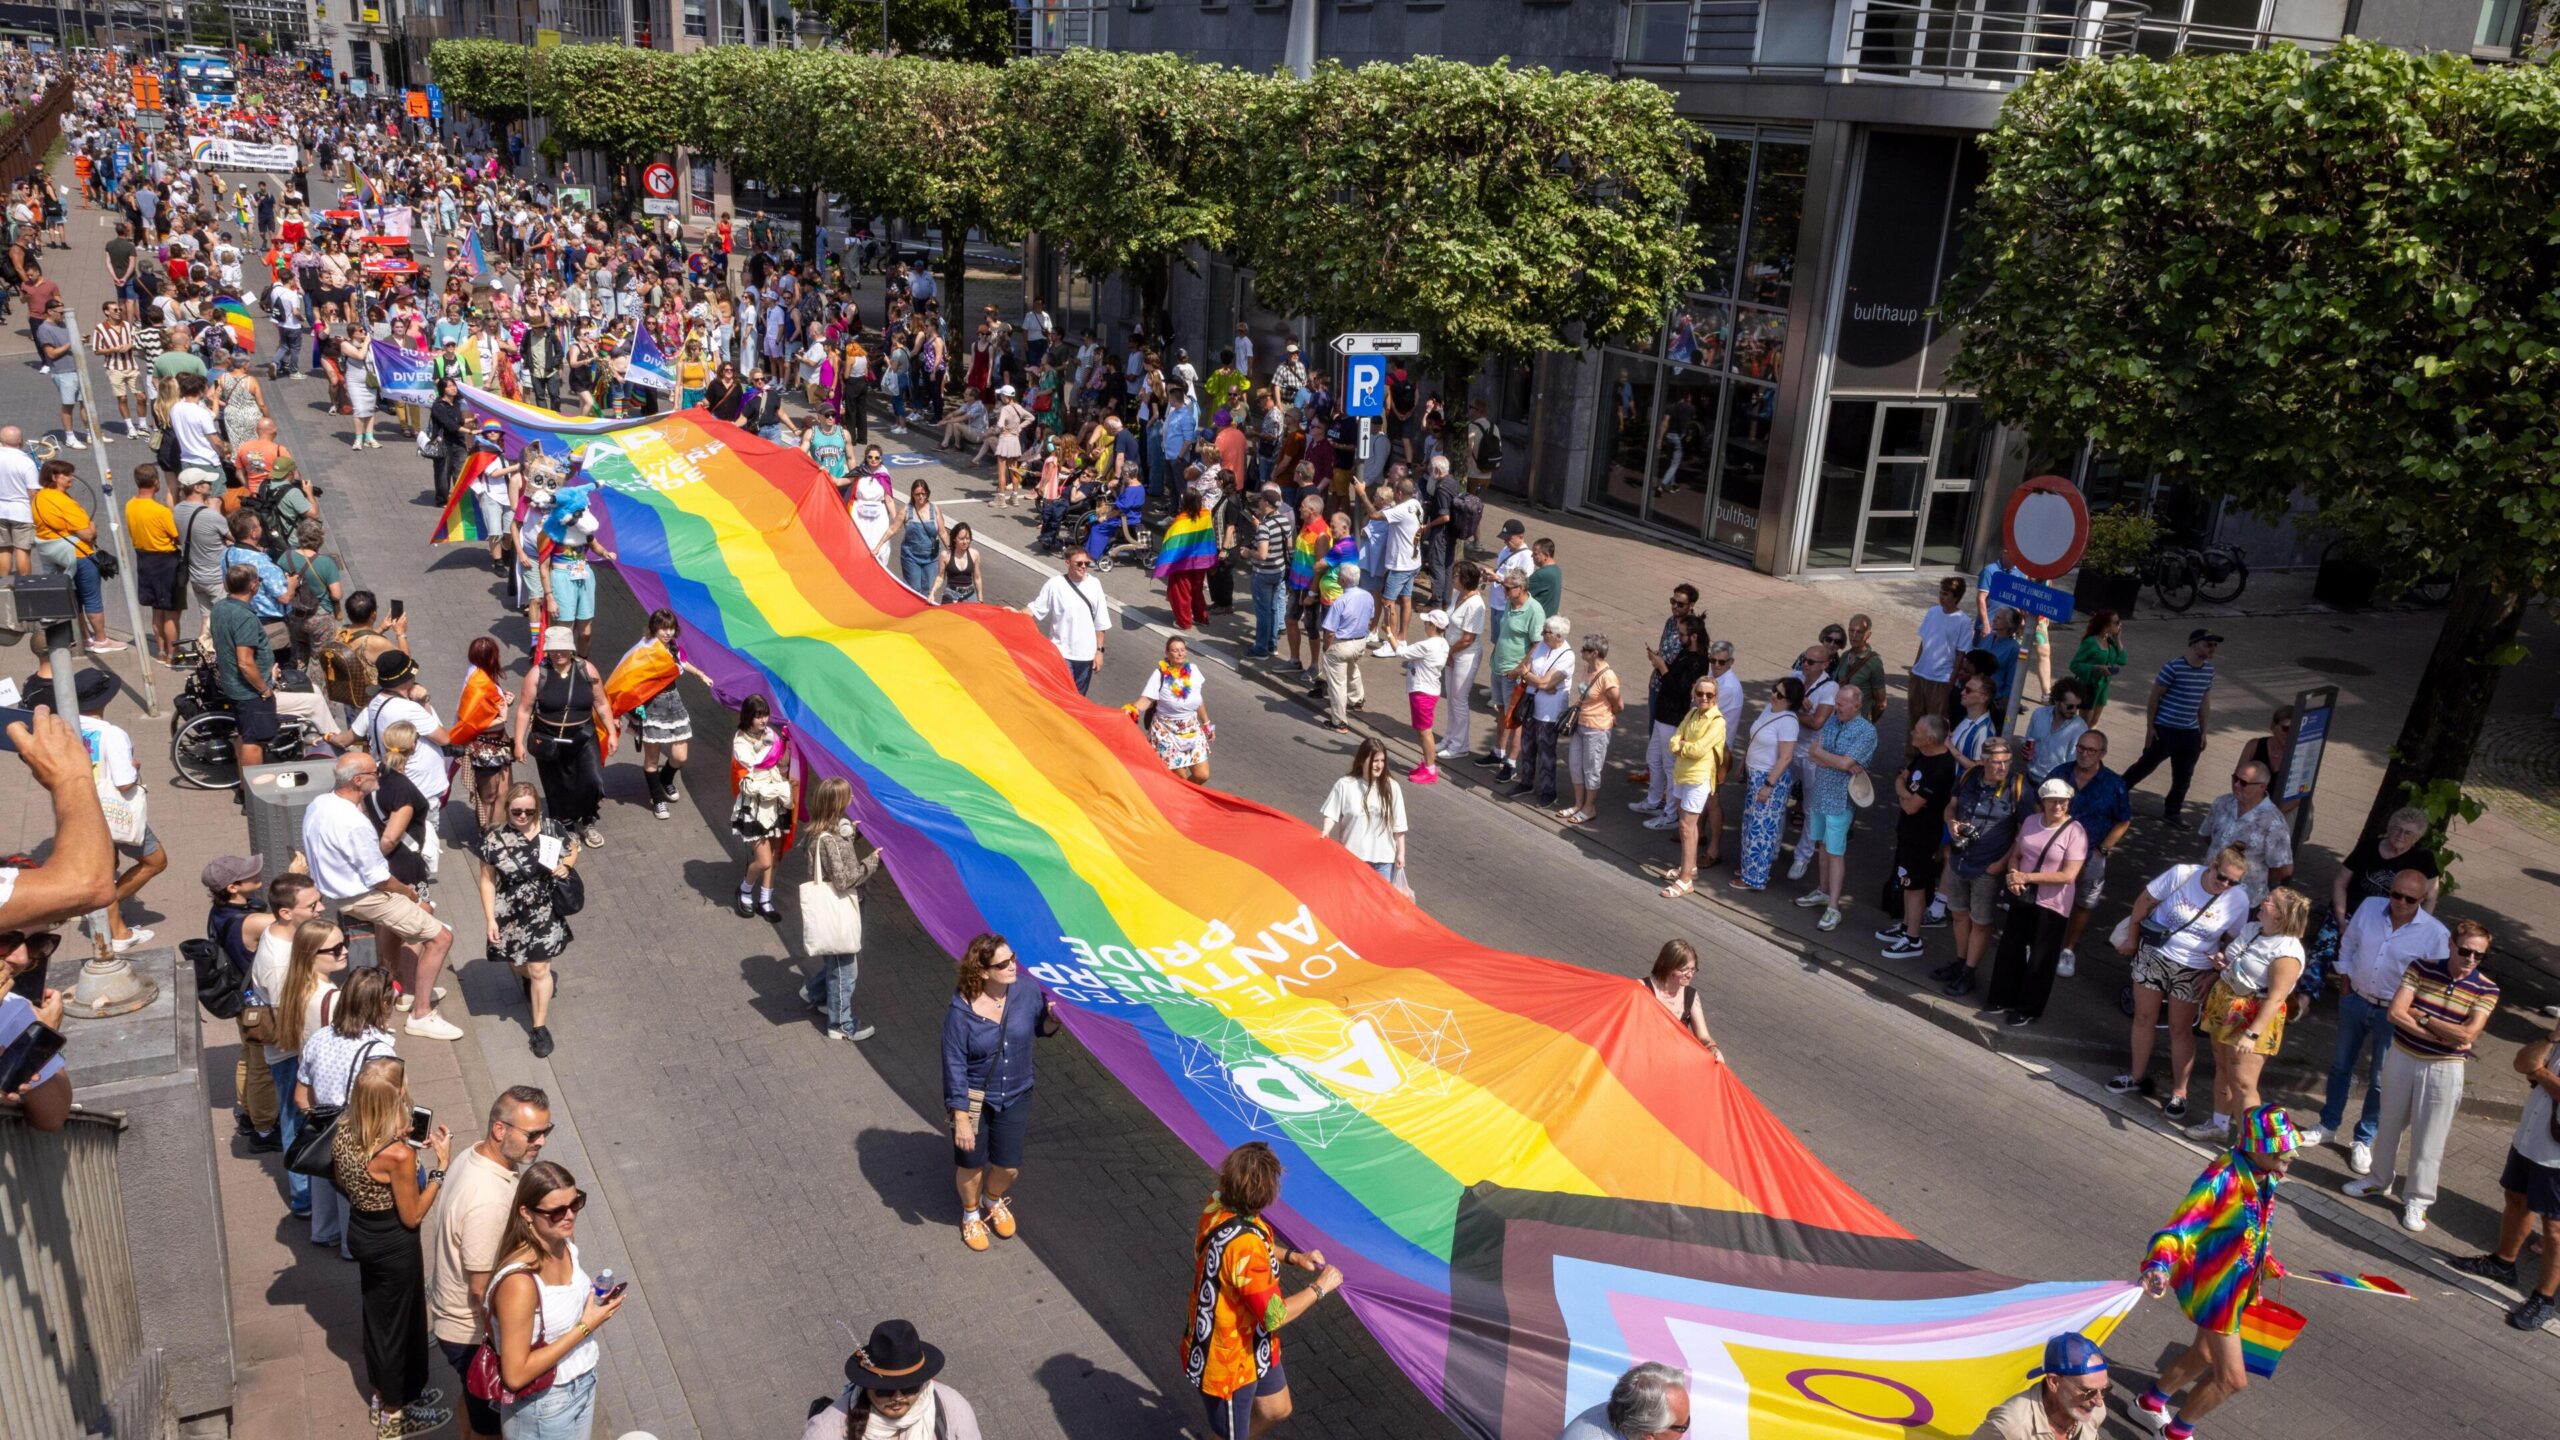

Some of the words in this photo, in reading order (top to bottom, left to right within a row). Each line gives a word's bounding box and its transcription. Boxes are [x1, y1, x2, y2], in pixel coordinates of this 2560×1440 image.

[1854, 302, 1918, 327] bulthaup
[1347, 338, 1355, 351] P
[393, 372, 433, 382] DIVER
[1352, 364, 1380, 407] P
[1715, 500, 1759, 530] bulthau
[1998, 591, 2017, 603] LADEN
[2036, 602, 2059, 616] LOSSEN
[2011, 582, 2052, 602] UITGEZONDERD
[1028, 904, 1319, 996] ANTWERP
[1059, 918, 1235, 974] PRIDE
[1239, 940, 1360, 1006] LOVE
[1051, 986, 1232, 1011] UNITED
